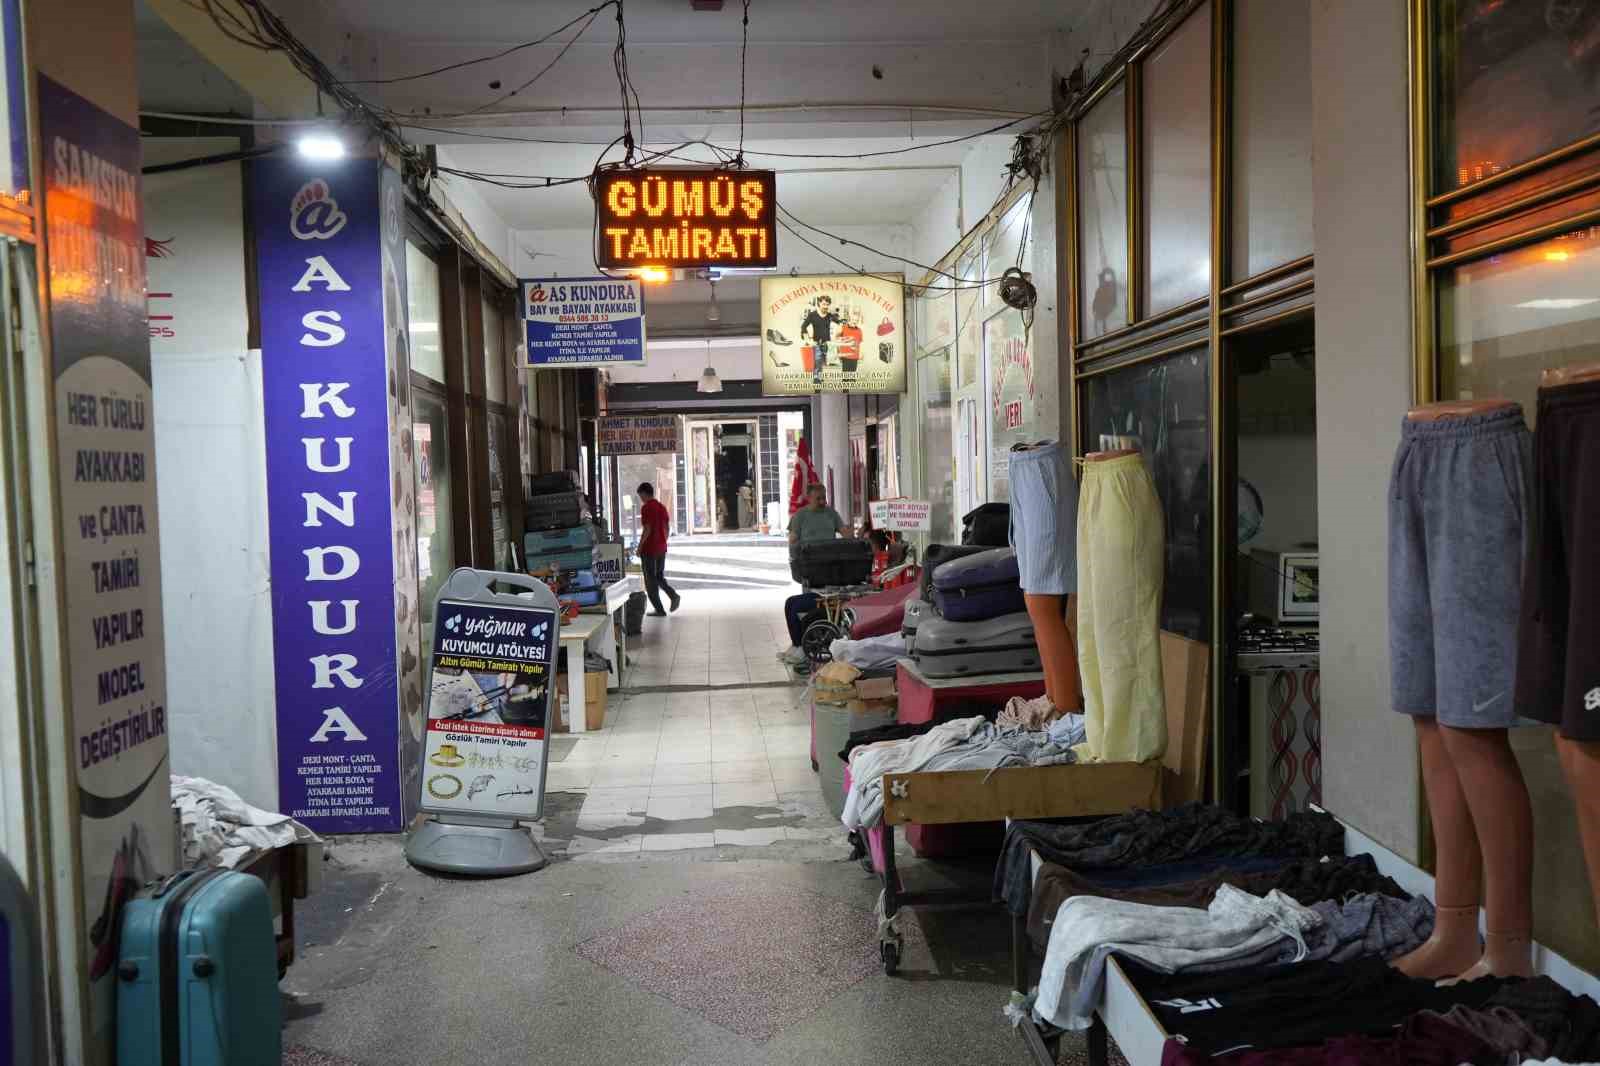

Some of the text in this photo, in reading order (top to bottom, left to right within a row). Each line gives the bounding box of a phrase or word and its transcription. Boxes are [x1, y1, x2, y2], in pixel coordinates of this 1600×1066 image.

[55, 136, 136, 222] SAMSUN
[608, 176, 763, 219] GÜMÜŞ
[606, 220, 767, 259] TAMİRATI
[291, 255, 352, 347] AS
[550, 286, 567, 301] AS
[570, 284, 636, 301] KUNDURA
[530, 302, 637, 315] BAY ve BAYAN AYAKKABI
[67, 390, 146, 431] HER TÜRLÜ
[75, 449, 145, 484] AYAKKABI
[79, 508, 145, 544] ve ÇANTA
[91, 550, 140, 593] TAMİRİ
[298, 381, 368, 743] KUNDURA
[92, 609, 145, 650] YAPILIR
[464, 616, 526, 638] YAĞMUR
[441, 638, 546, 660] KUYUMCU ATÖLYESİ
[440, 657, 544, 675] Altın Gümüş Tamiratı Yapılır
[97, 661, 145, 706] MODEL
[80, 704, 165, 770] DEĞİŞTİRİLİR
[435, 720, 451, 730] Özel
[470, 723, 496, 734] üzerine
[496, 726, 519, 737] sipariş
[445, 733, 473, 744] Gözlük
[501, 739, 528, 748] Yapılır
[297, 764, 382, 775] KEMER TAMİRİ YAPILIR
[303, 755, 321, 764] DERİ
[322, 755, 345, 764] MONT
[350, 754, 376, 765] ÇANTA
[305, 776, 322, 785] HER
[322, 776, 344, 785] RENK
[345, 776, 366, 785] BOYA
[307, 786, 374, 796] AYAKKABI BAKIMI
[330, 797, 344, 806] İLE
[344, 796, 374, 806] YAPILIR
[292, 808, 330, 818] AYAKKABI
[363, 807, 391, 816] ALINIR
